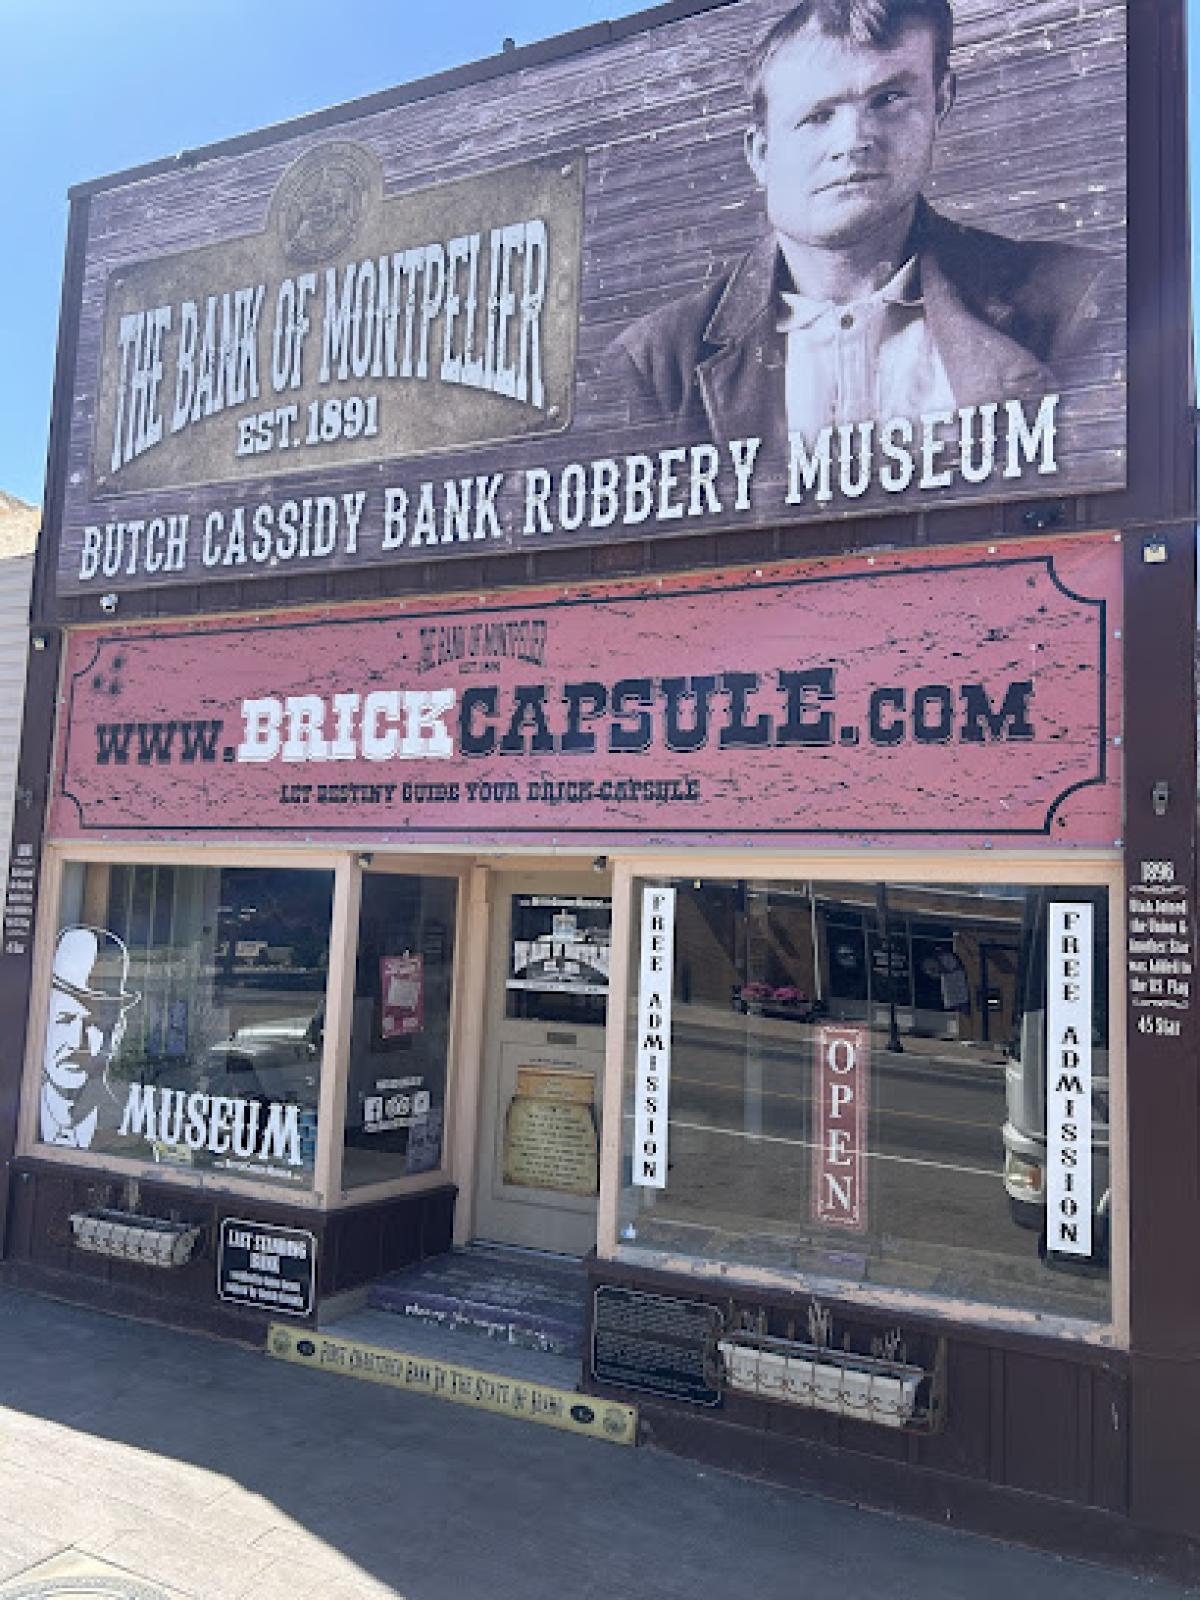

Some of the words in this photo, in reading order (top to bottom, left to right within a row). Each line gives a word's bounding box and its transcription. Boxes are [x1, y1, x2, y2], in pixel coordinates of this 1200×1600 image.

[111, 306, 171, 473] THE
[170, 285, 265, 433] BANK
[272, 273, 315, 392] OF
[319, 220, 549, 410] MONTPELIER
[79, 513, 189, 582] BUTCH
[202, 491, 366, 567] CASSIDY
[382, 472, 505, 551] BANK
[523, 437, 762, 536] ROBBERY
[785, 394, 1061, 505] MUSEUM
[402, 781, 460, 804] GUIDE
[466, 781, 521, 804] YOUR
[651, 893, 666, 972] FREE
[1062, 911, 1081, 1002] FREE
[118, 1082, 304, 1166] MUSEUM
[643, 993, 666, 1178] ADMISSION
[825, 1037, 855, 1211] OPEN
[1055, 1025, 1086, 1243] ADMISSION
